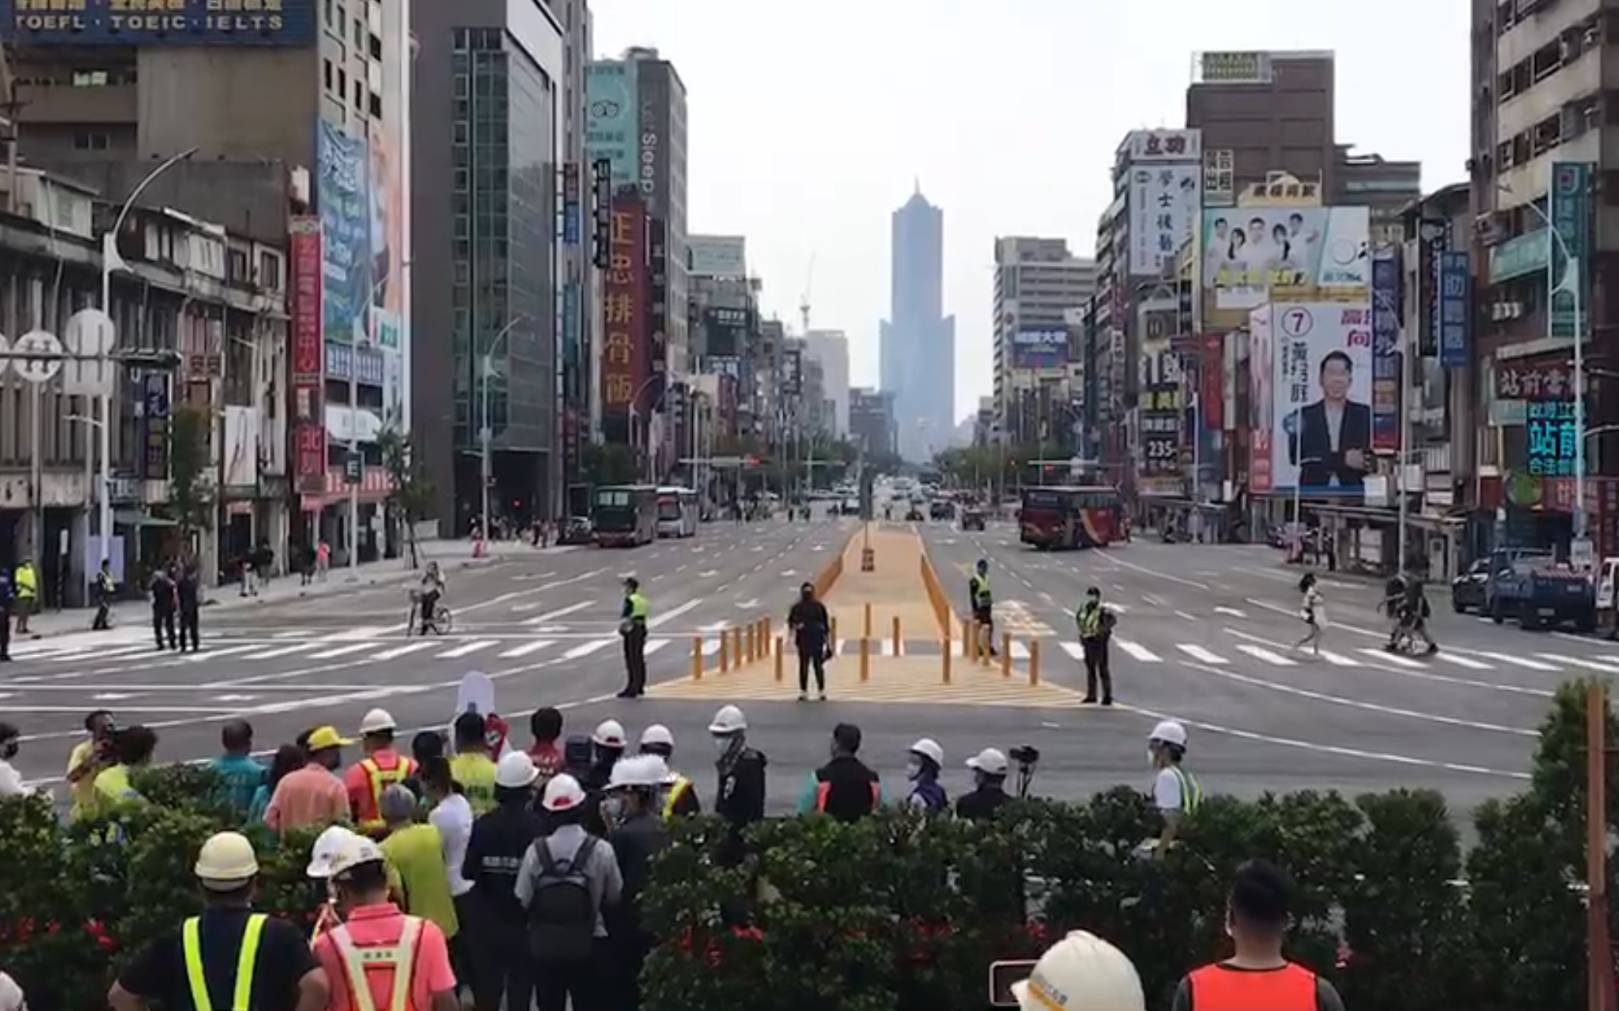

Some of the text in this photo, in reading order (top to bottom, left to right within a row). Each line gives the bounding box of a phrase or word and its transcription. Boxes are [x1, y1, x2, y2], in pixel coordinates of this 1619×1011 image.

[16, 15, 283, 29] TOEFL TOEIC IELTS
[606, 212, 635, 404] 正忠排骨飯
[1292, 312, 1304, 332] 7
